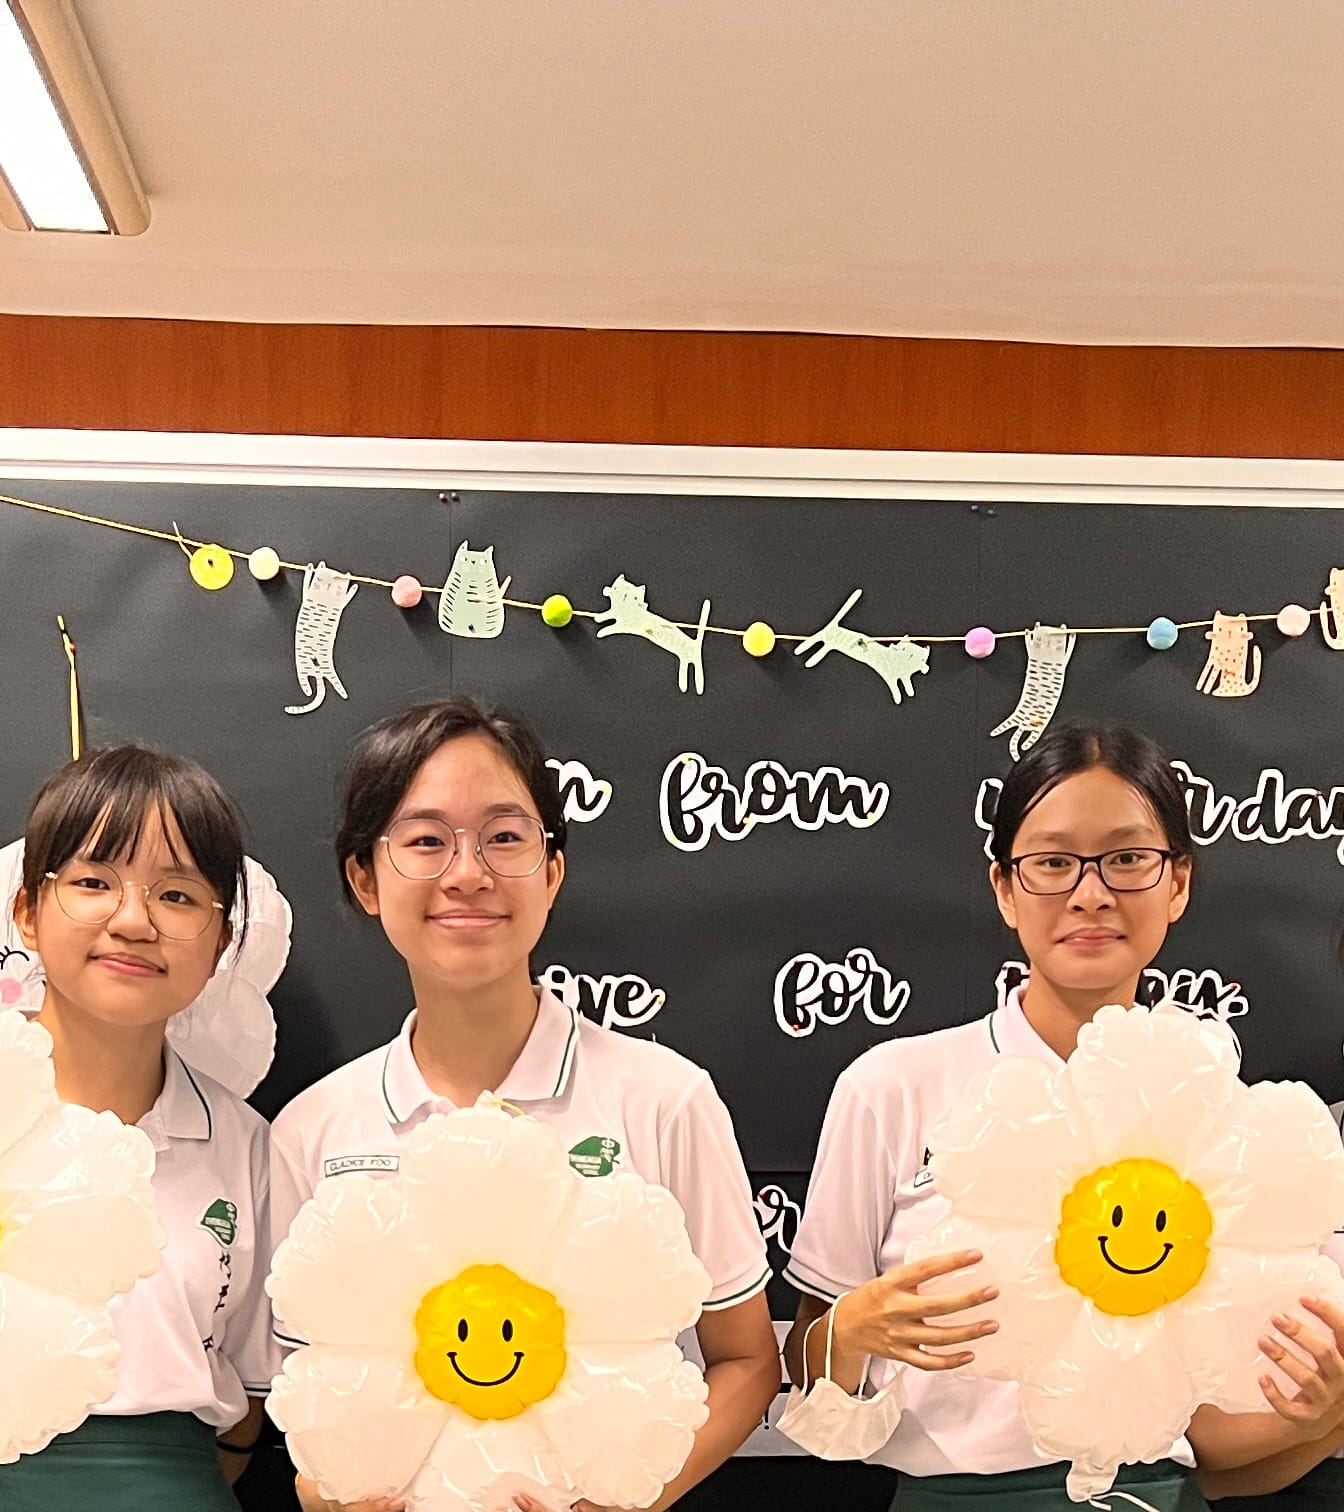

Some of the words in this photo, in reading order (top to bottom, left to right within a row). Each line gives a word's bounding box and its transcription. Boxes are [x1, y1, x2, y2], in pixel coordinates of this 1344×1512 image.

[664, 755, 886, 847] from
[549, 968, 663, 1025] ive
[778, 951, 908, 1034] for
